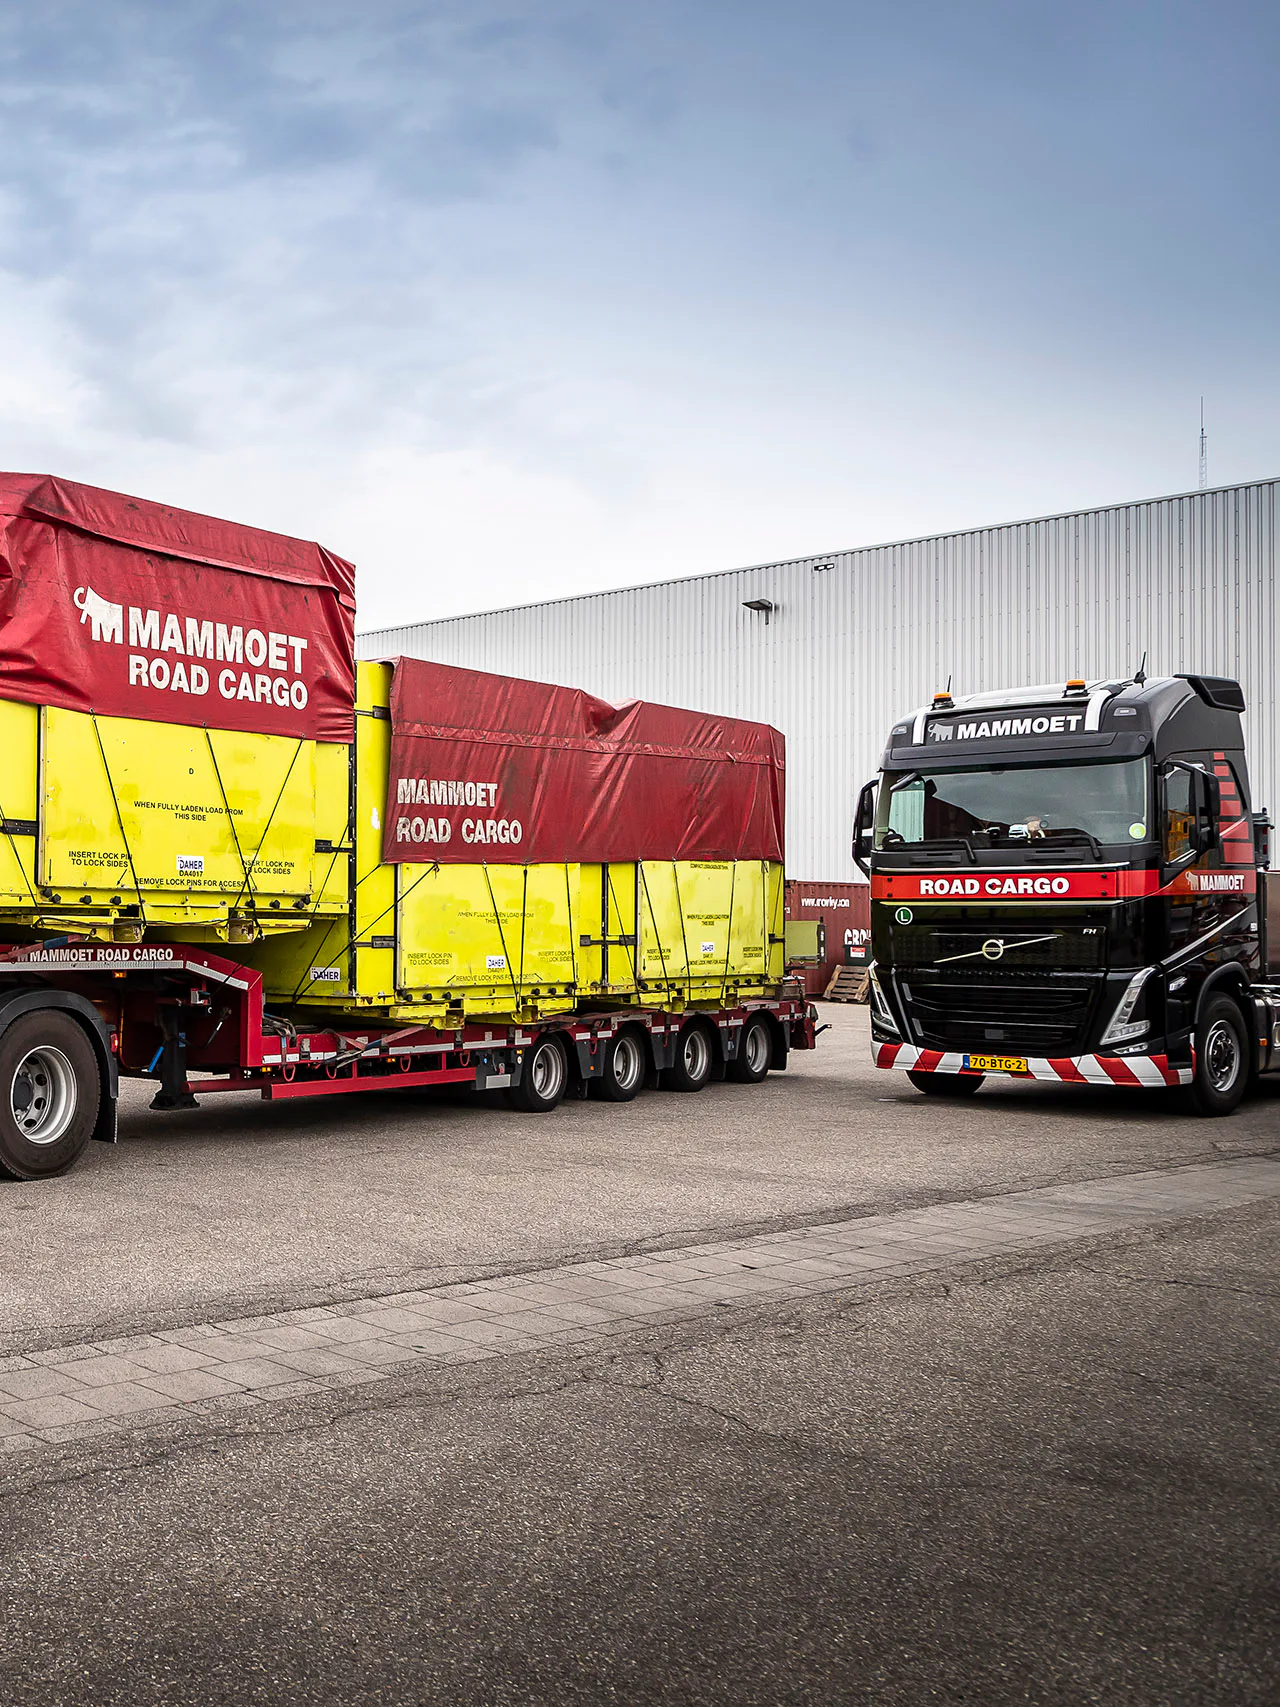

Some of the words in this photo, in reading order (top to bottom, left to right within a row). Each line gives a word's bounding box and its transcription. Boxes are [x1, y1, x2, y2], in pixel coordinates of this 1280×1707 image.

[128, 606, 308, 674] MAMMOET
[128, 654, 210, 696] ROAD
[218, 668, 309, 710] CARGO
[957, 715, 1083, 740] MAMMOET
[397, 778, 498, 808] MAMMOET
[134, 801, 156, 809] WHEN
[157, 802, 179, 811] FULLY
[396, 816, 452, 843] ROAD
[461, 818, 523, 844] CARGO
[98, 852, 119, 860] LOCK
[107, 860, 129, 868] SIDES
[179, 860, 203, 870] DAHER
[165, 878, 185, 886] LOCK
[920, 879, 980, 895] ROAD
[985, 877, 1070, 895] CARGO
[1200, 875, 1245, 890] MAMMOET
[900, 910, 908, 922] L
[30, 949, 94, 962] MAMMOET
[96, 948, 129, 961] ROAD
[133, 948, 174, 961] CARGO
[488, 959, 504, 967] DAHER
[313, 970, 339, 980] DAHER
[972, 1057, 1022, 1070] 70-BTG-2
